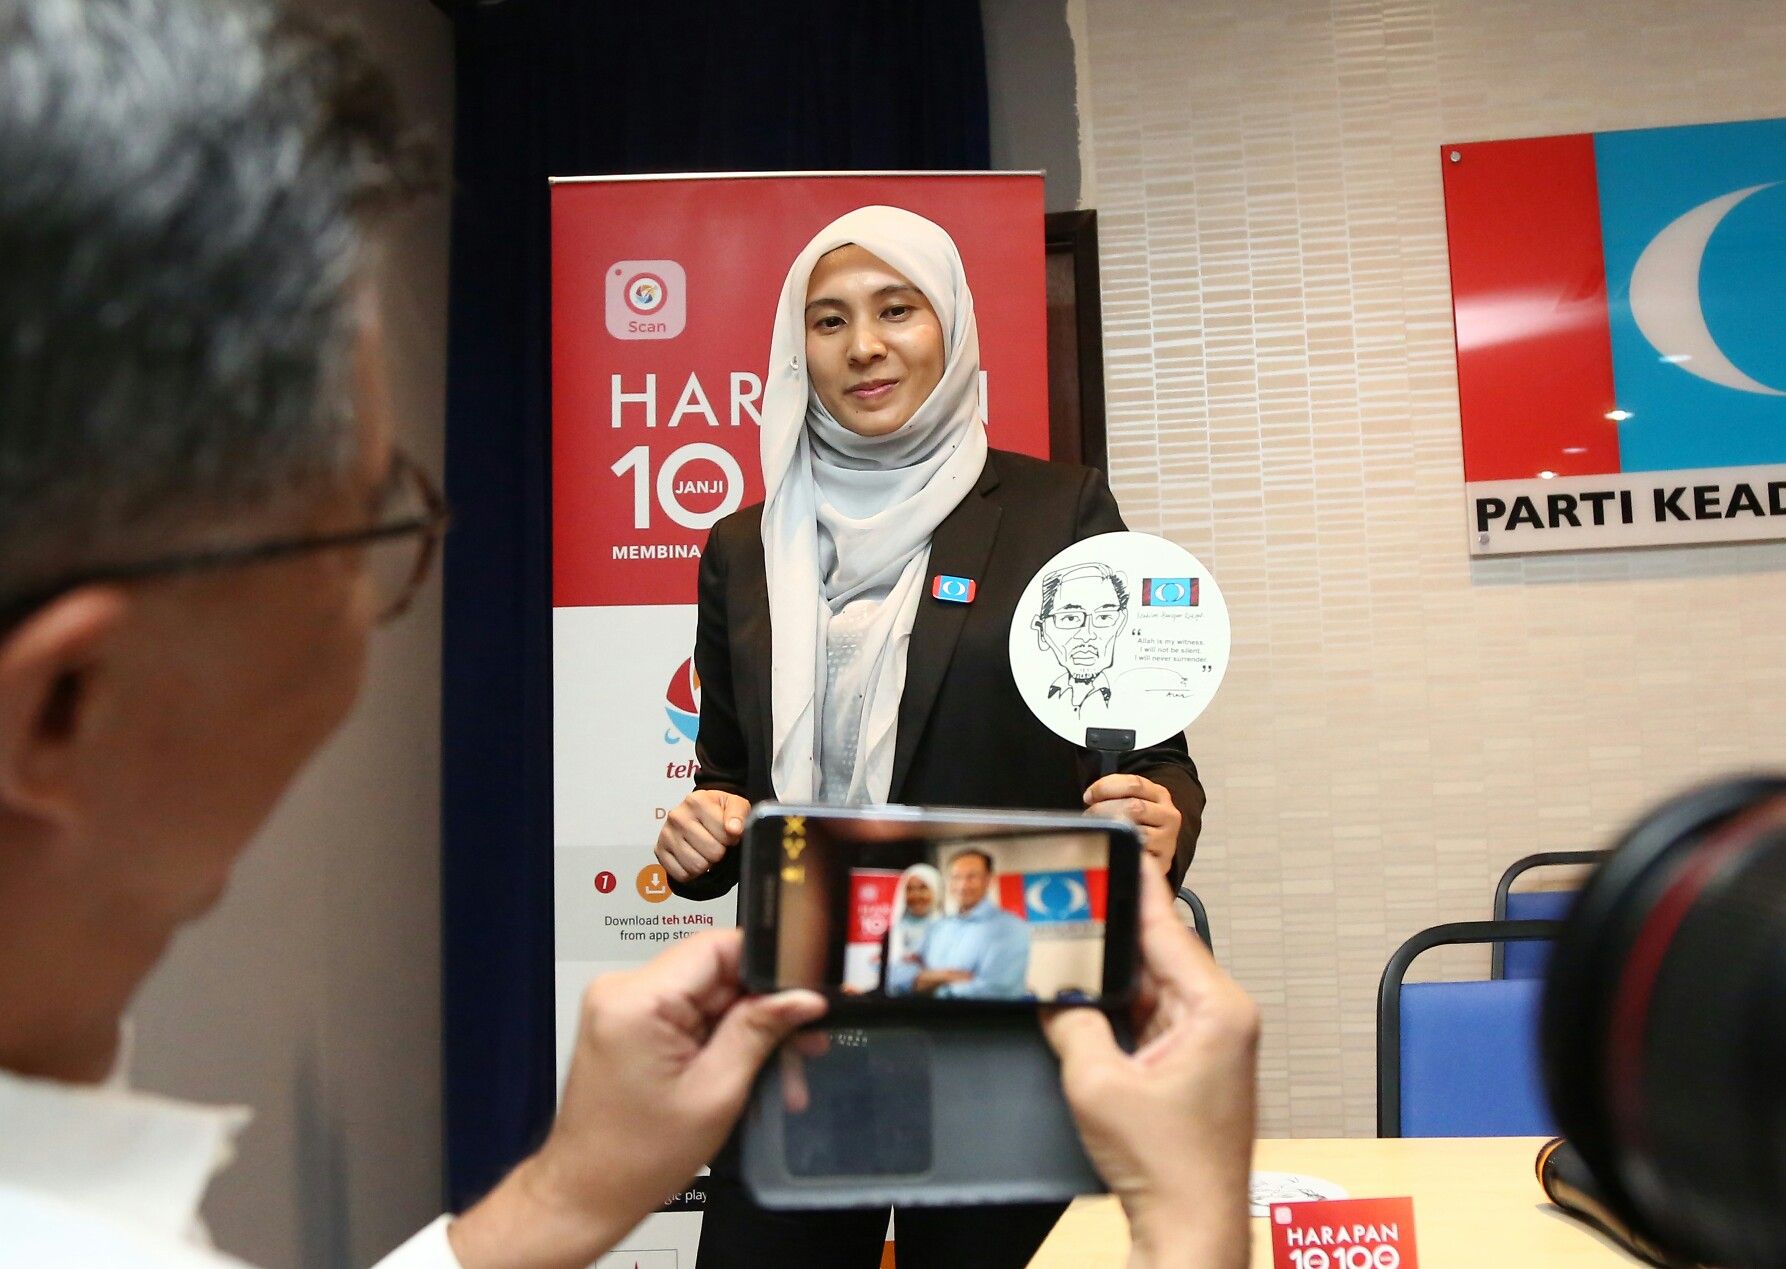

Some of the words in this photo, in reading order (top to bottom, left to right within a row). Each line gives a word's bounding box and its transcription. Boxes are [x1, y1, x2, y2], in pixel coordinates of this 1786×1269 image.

[628, 320, 666, 333] Scan
[675, 480, 724, 494] JANJI
[1475, 489, 1634, 532] PARTI
[612, 544, 701, 560] MEMBINA
[604, 915, 659, 926] Download
[662, 915, 680, 925] teh
[683, 914, 714, 926] tARiq
[620, 930, 646, 941] from
[649, 932, 670, 942] app
[685, 1189, 707, 1204] play
[1286, 1222, 1399, 1247] HARAPAN
